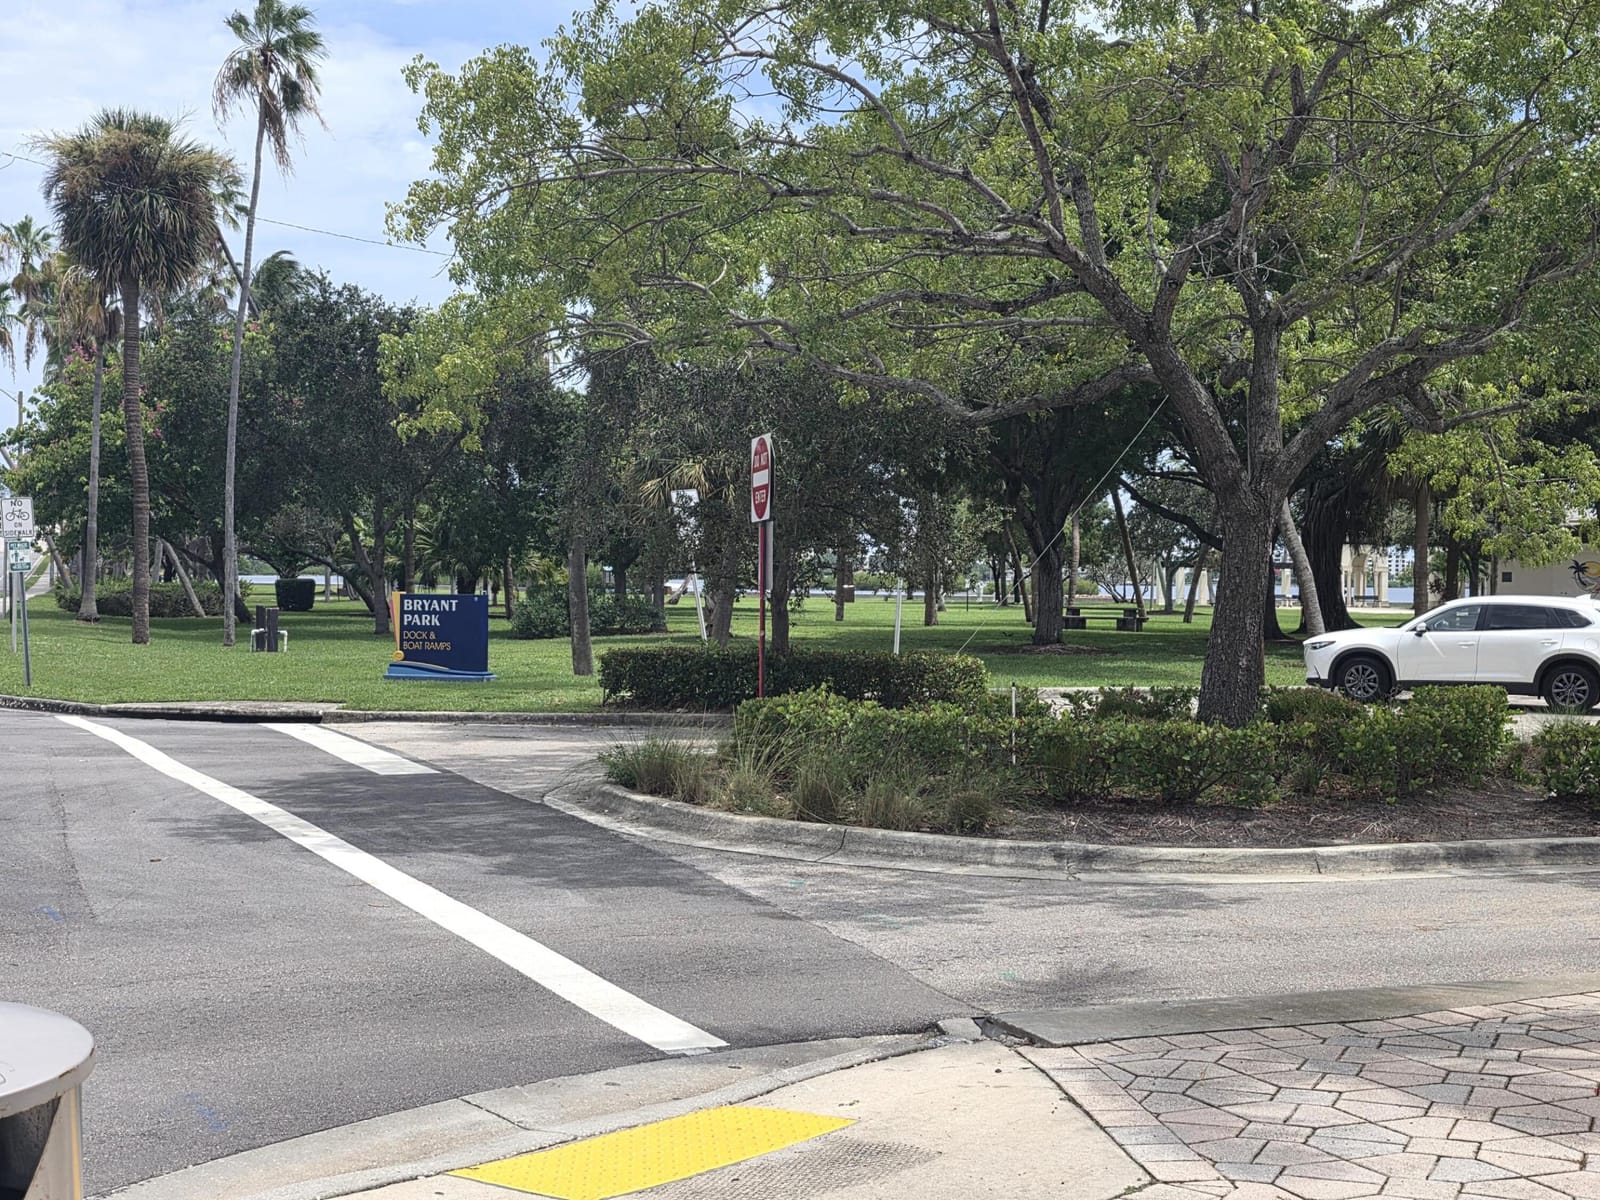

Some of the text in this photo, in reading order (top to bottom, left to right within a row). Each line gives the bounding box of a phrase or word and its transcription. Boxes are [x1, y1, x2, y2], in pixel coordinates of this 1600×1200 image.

[754, 451, 768, 468] DO NOT
[755, 489, 766, 505] ENTER
[403, 599, 459, 612] BRYANT
[403, 614, 441, 626] PARK
[403, 631, 436, 640] DOCK &
[403, 641, 452, 651] BOAT RAMPS
